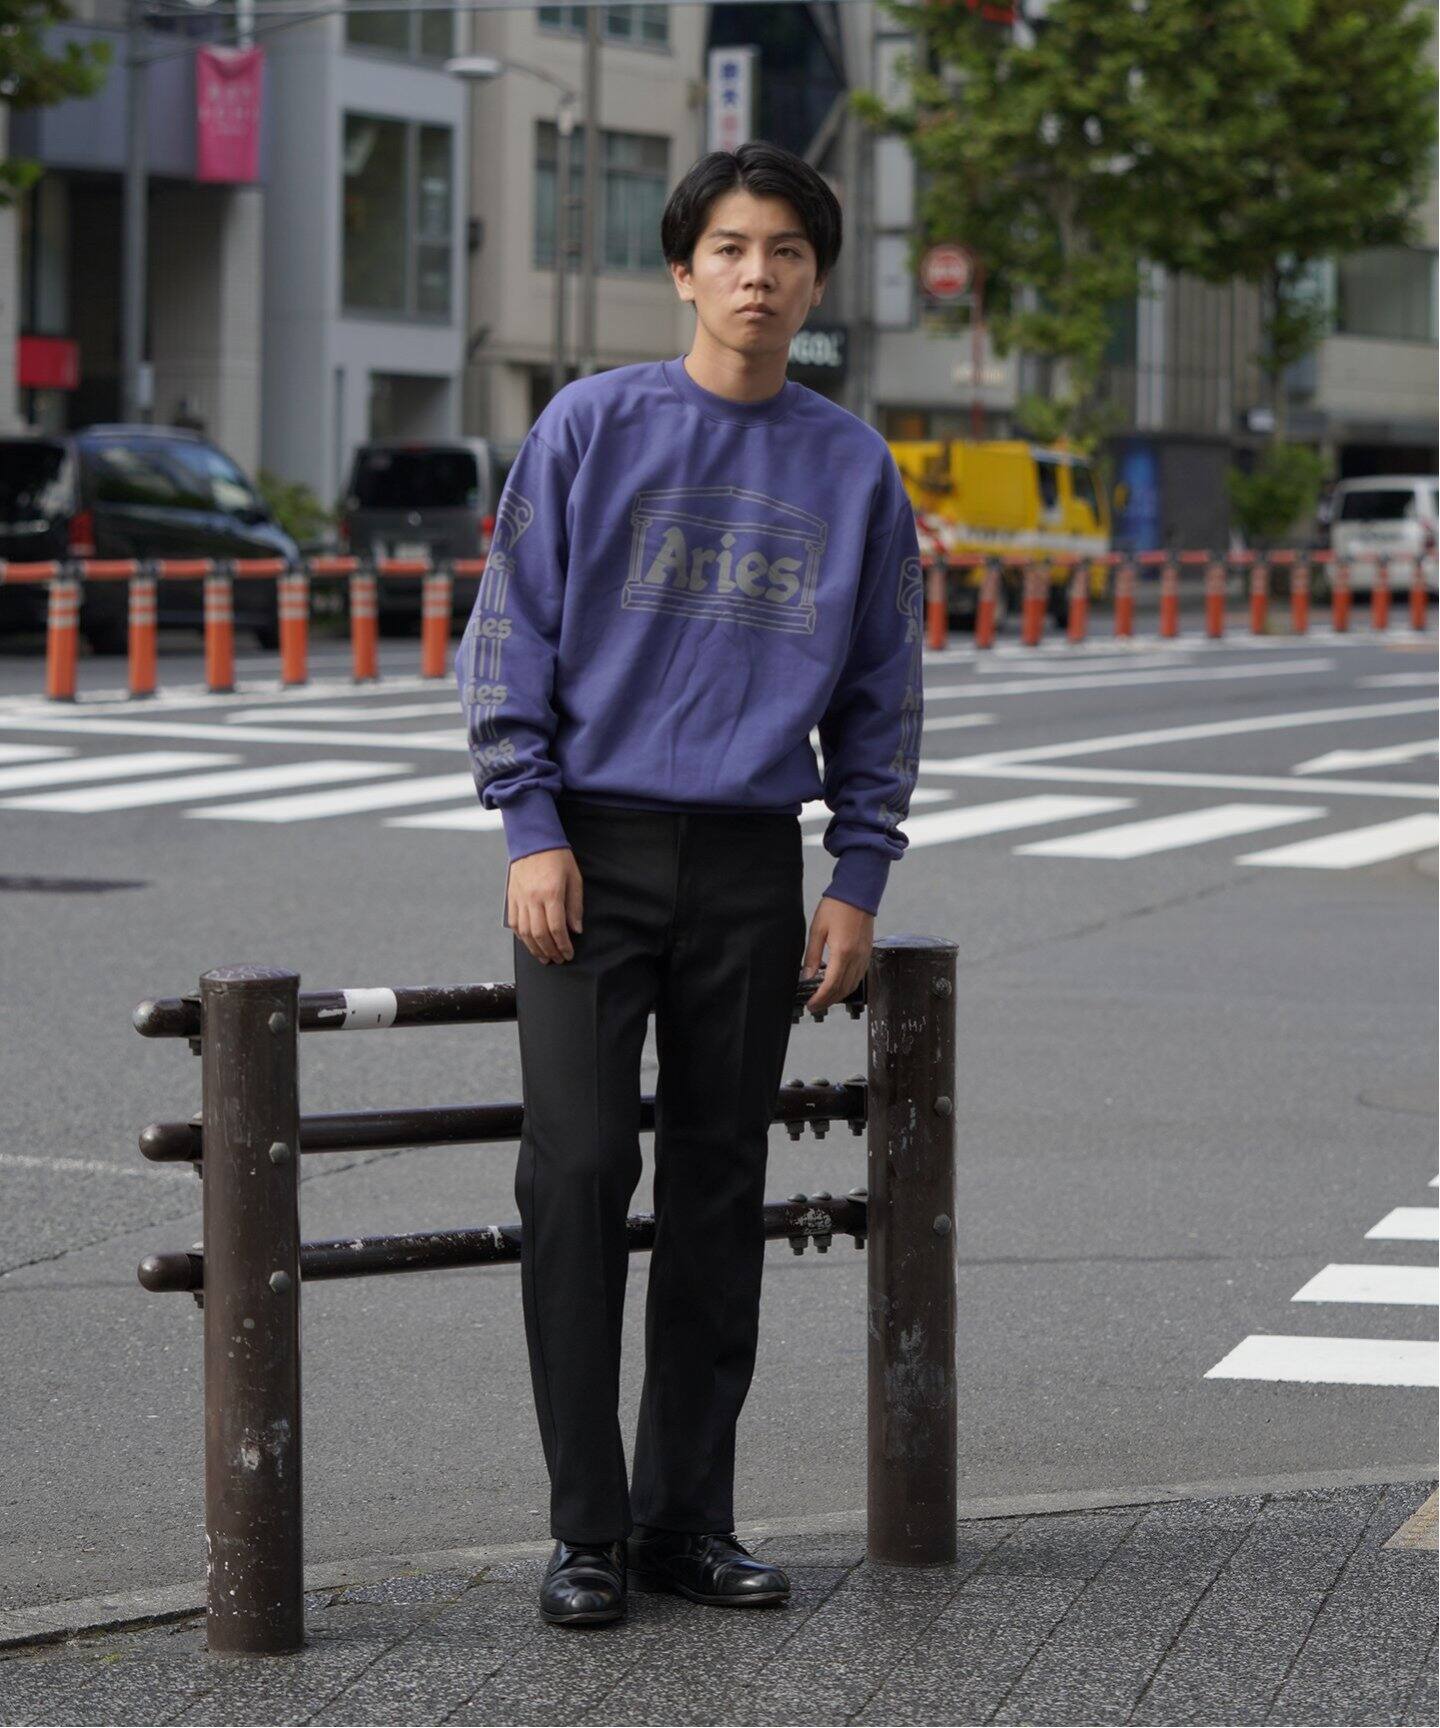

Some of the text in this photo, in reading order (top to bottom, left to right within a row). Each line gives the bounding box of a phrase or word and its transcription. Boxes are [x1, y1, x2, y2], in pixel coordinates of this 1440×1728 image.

[643, 526, 803, 603] Aries
[469, 608, 513, 640] ies
[464, 677, 508, 706] ies
[472, 737, 516, 767] ies
